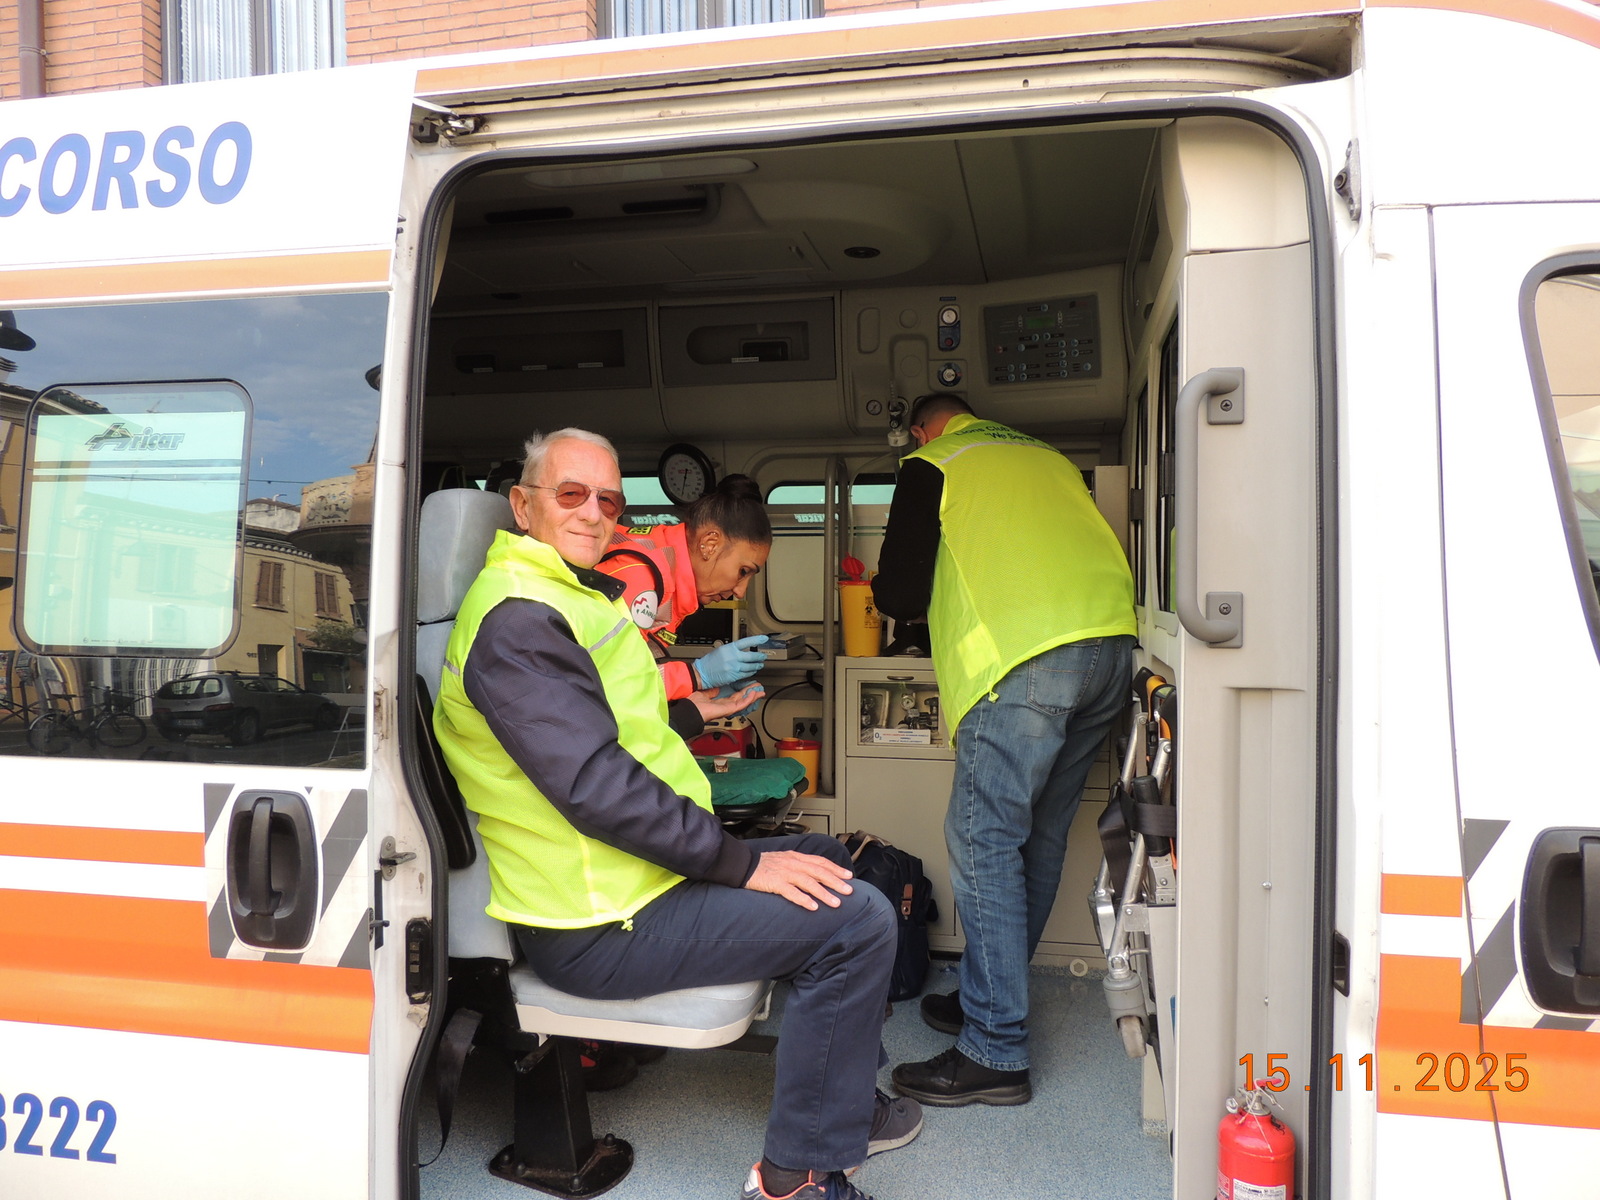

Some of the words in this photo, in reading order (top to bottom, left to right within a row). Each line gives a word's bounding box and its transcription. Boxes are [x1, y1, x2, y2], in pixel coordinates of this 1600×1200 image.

[0, 121, 252, 217] CORSO
[85, 423, 185, 451] Aricar
[0, 1092, 117, 1165] 222
